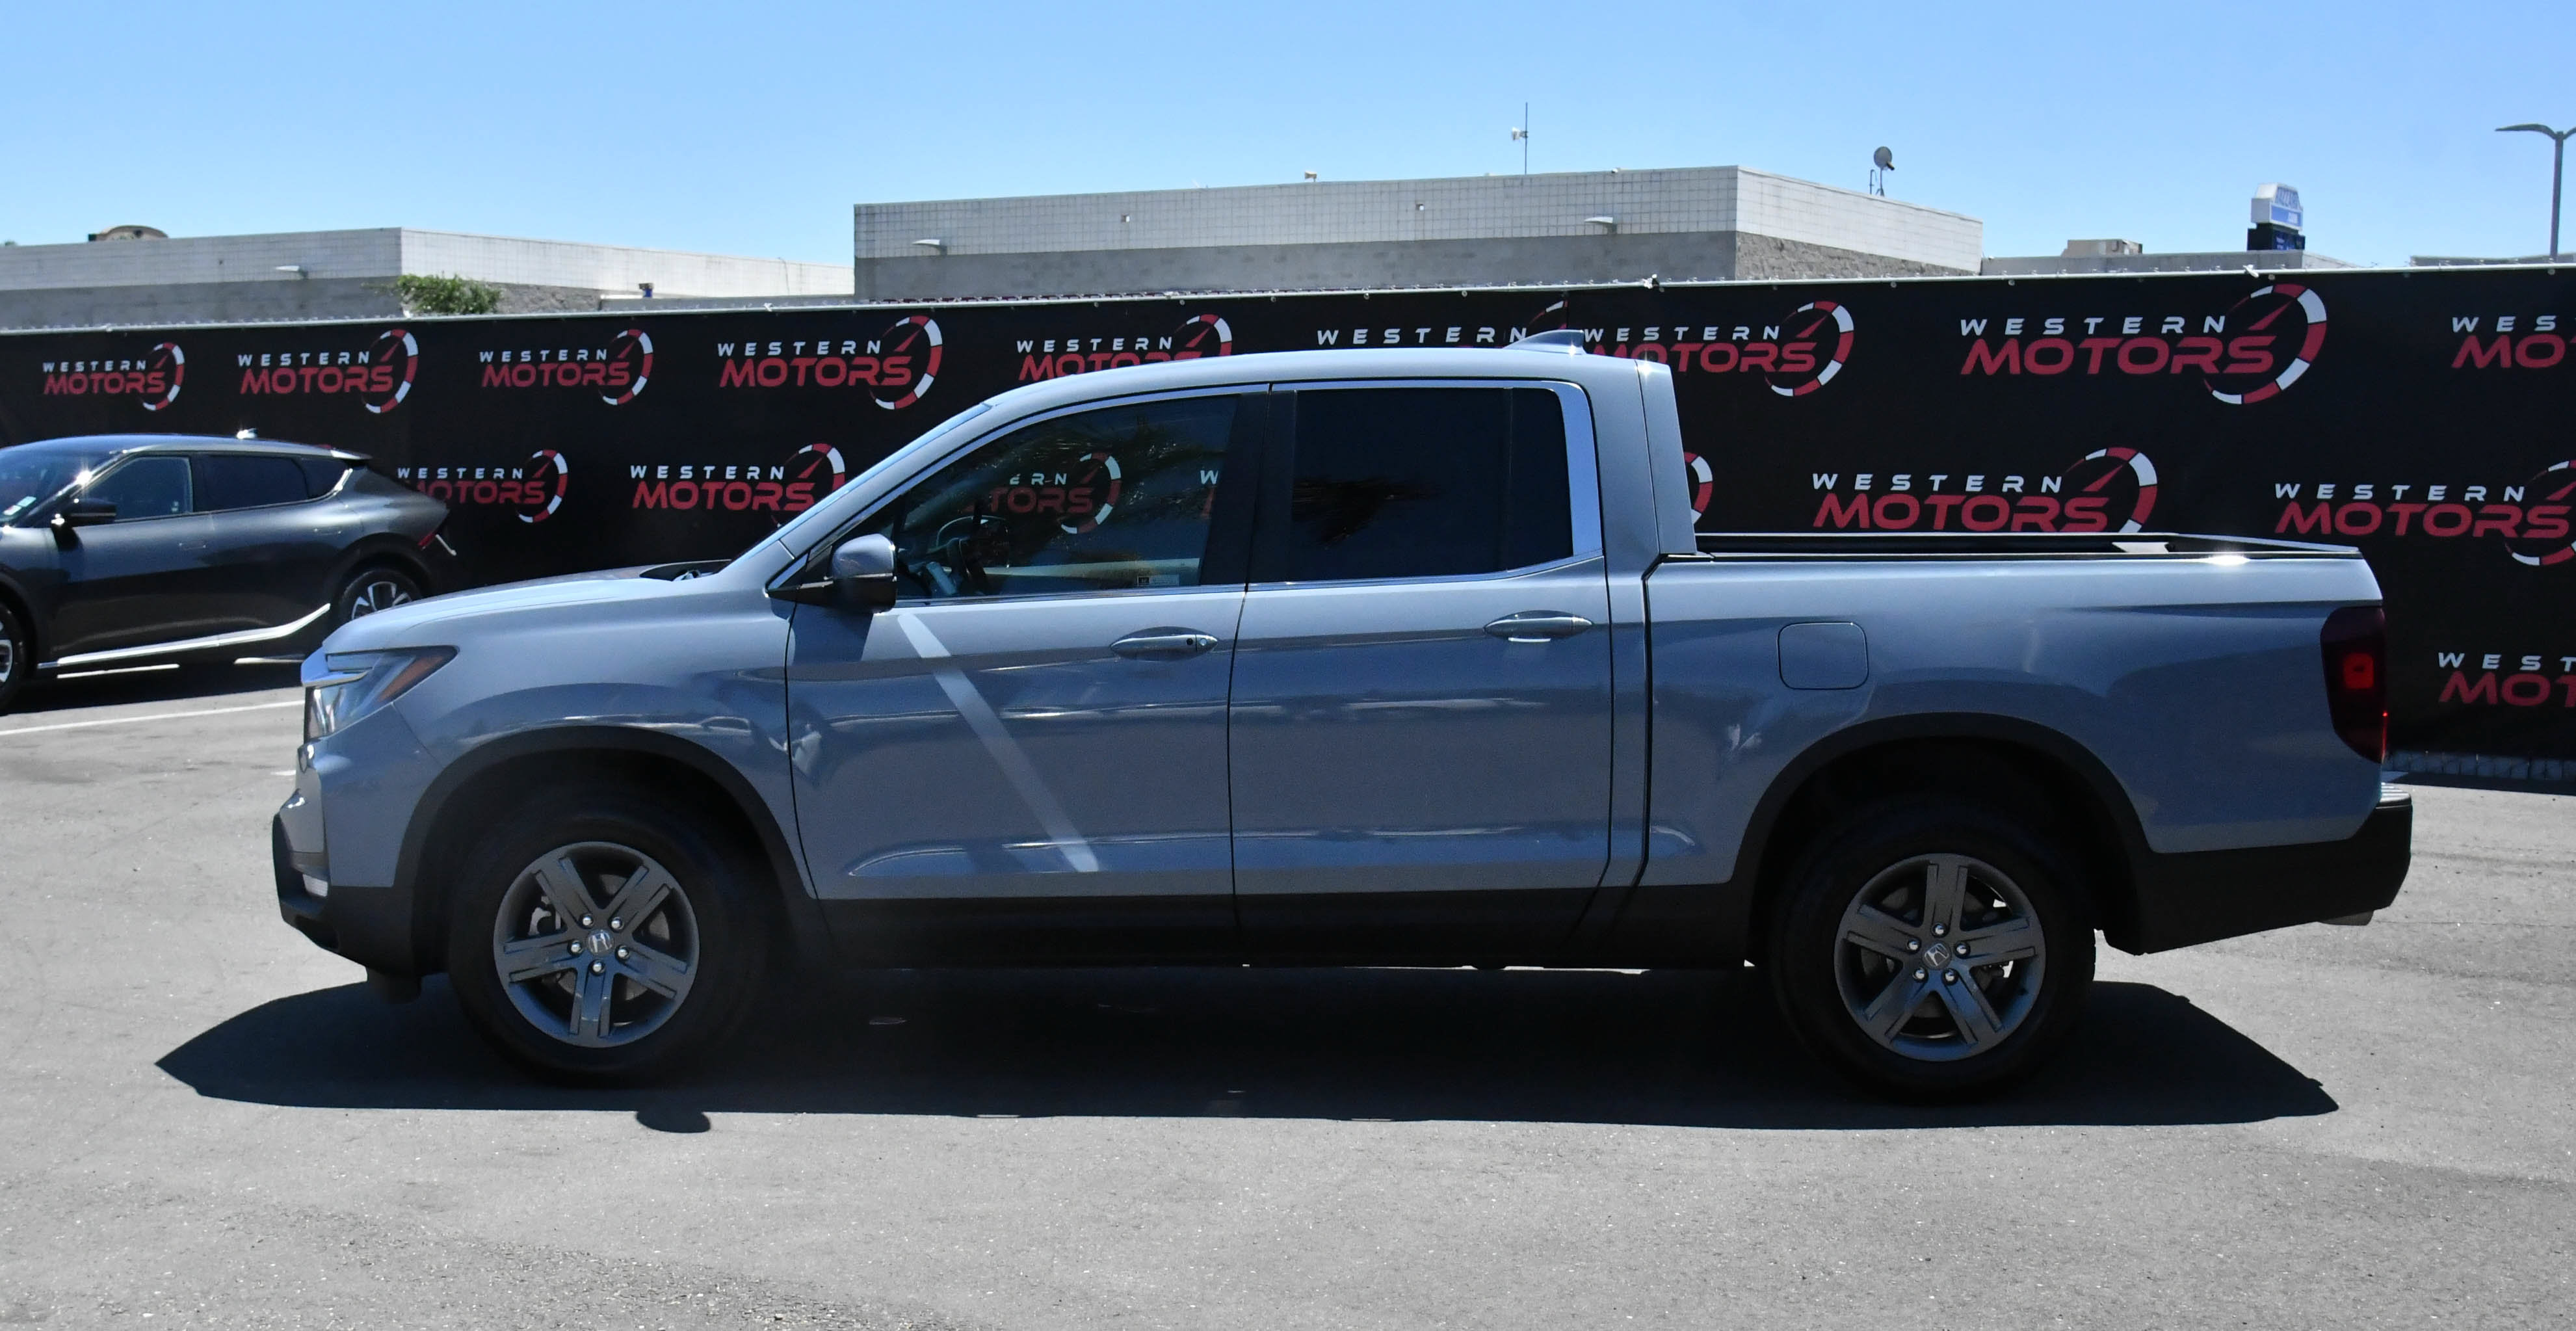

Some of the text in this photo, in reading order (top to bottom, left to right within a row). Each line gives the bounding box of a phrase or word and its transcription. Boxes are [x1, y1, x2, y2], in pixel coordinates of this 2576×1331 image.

[1317, 327, 1527, 345] WESTERN
[1584, 325, 1780, 342] WESTERN
[1960, 316, 2226, 336] WESTERN
[717, 339, 881, 357] WESTERN
[1016, 336, 1172, 353] WESTERN
[237, 351, 370, 367] WESTERN
[479, 349, 607, 363] WESTERN
[1960, 336, 2276, 375] MOTORS
[42, 360, 146, 373] WESTERN
[482, 361, 631, 388] MOTORS
[720, 356, 912, 388] MOTORS
[44, 371, 166, 395] MOTORS
[240, 365, 393, 394] MOTORS
[397, 468, 523, 479] WESTERN
[630, 465, 784, 481] WESTERN
[1813, 473, 2062, 493] WESTERN
[417, 481, 545, 504] OTORS
[632, 481, 815, 511] MOTORS
[990, 487, 1093, 514] TORS
[2275, 483, 2525, 502] WESTERN
[1813, 493, 2109, 532] MOTORS
[2275, 501, 2571, 538] MOTORS
